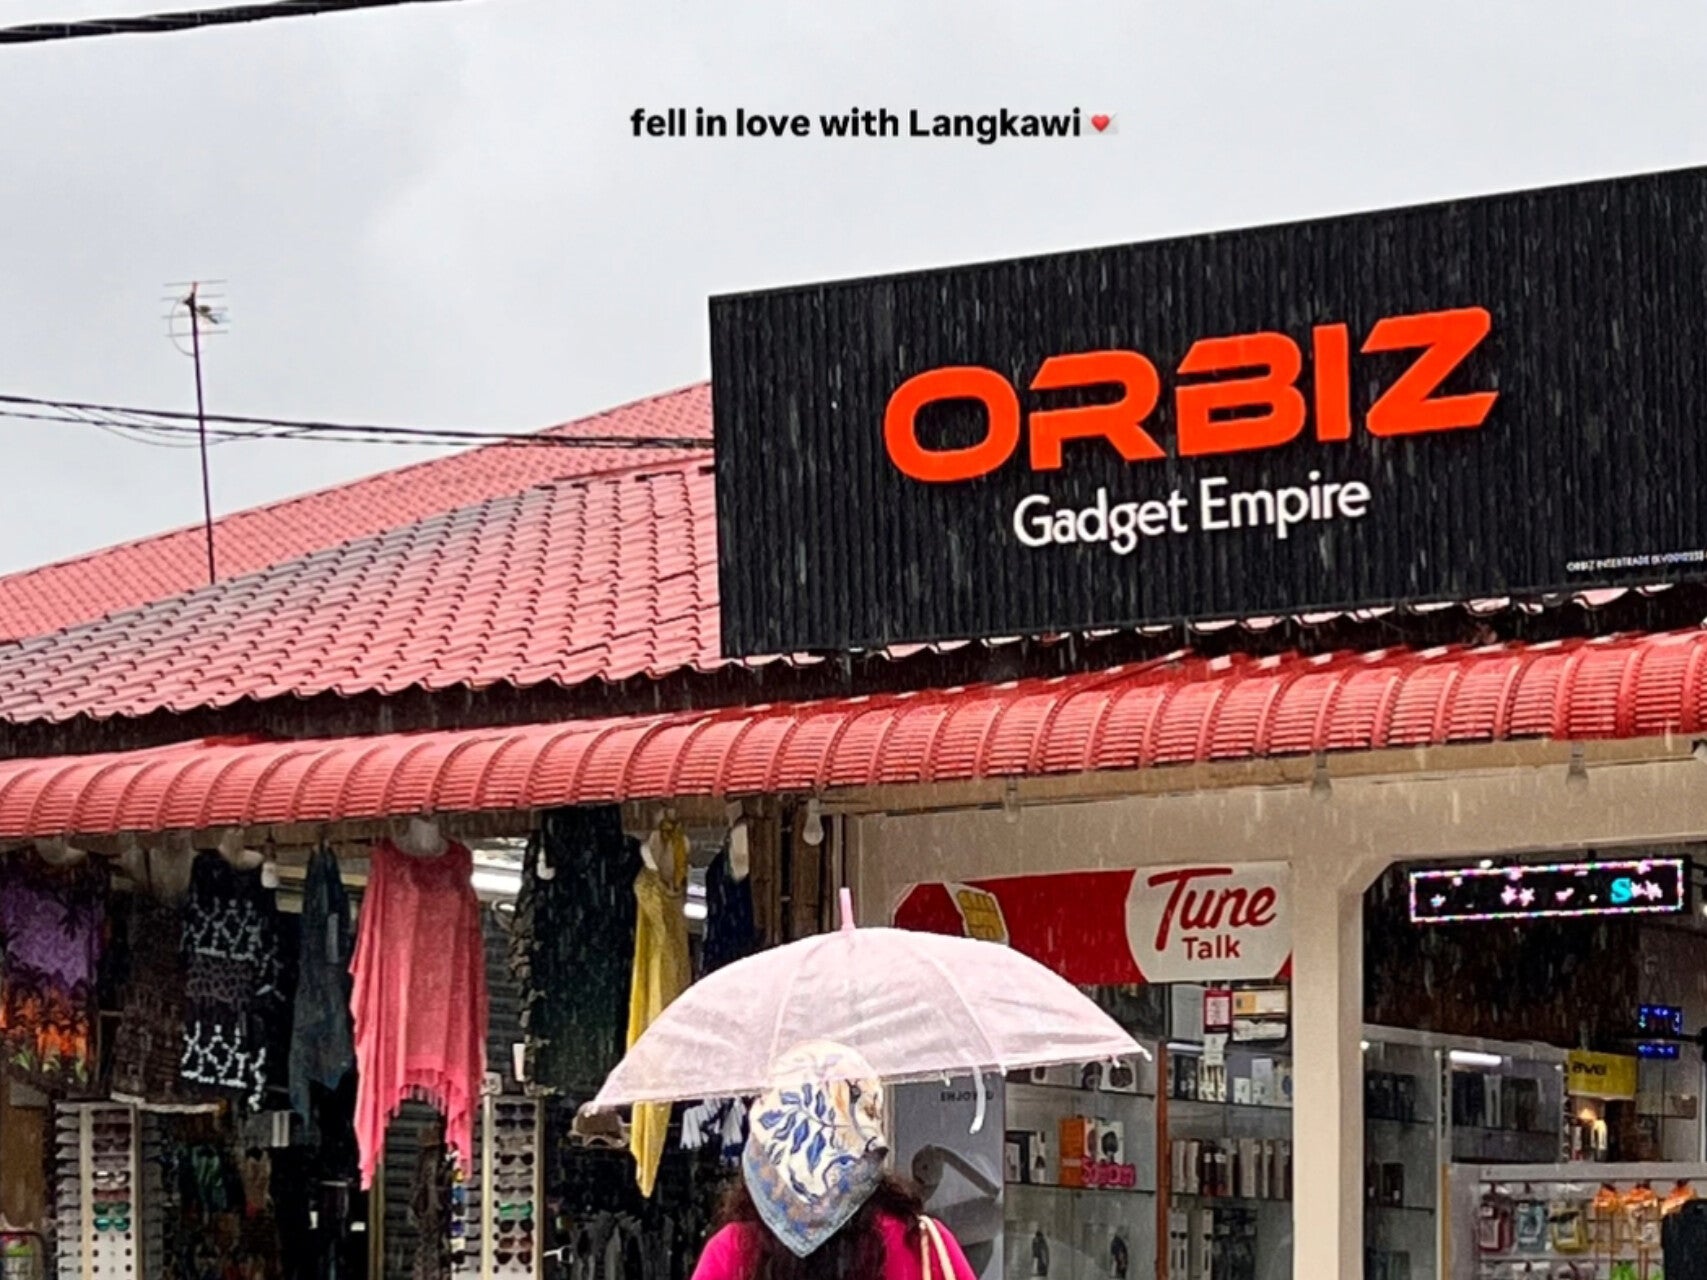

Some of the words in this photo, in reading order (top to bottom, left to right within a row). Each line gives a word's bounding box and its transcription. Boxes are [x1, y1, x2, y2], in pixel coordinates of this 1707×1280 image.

[884, 306, 1498, 482] ORBIZ
[1013, 488, 1188, 555] Gadget
[1200, 470, 1372, 539] Empire
[1147, 867, 1277, 951] Tune
[1181, 934, 1241, 961] Talk
